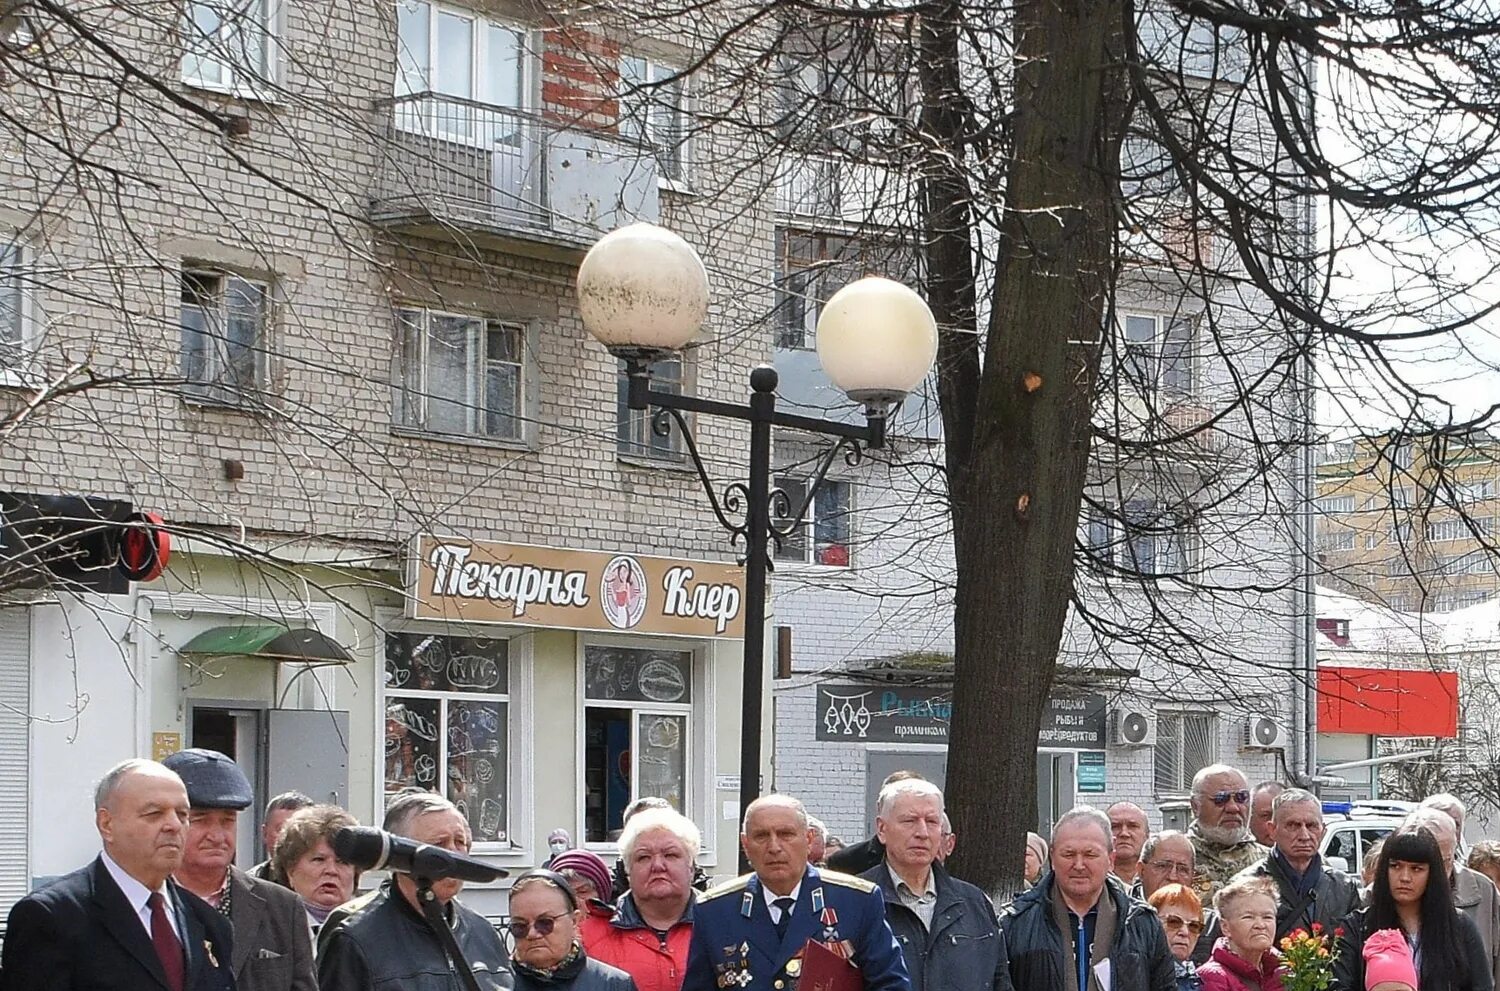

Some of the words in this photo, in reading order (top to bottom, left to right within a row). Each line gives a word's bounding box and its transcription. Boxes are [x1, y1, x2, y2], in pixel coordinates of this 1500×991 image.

[430, 544, 591, 617] Пекарня
[663, 566, 740, 634] Клер
[1051, 698, 1086, 710] ПРОДАЖА
[1055, 714, 1077, 725] РЫБЫ
